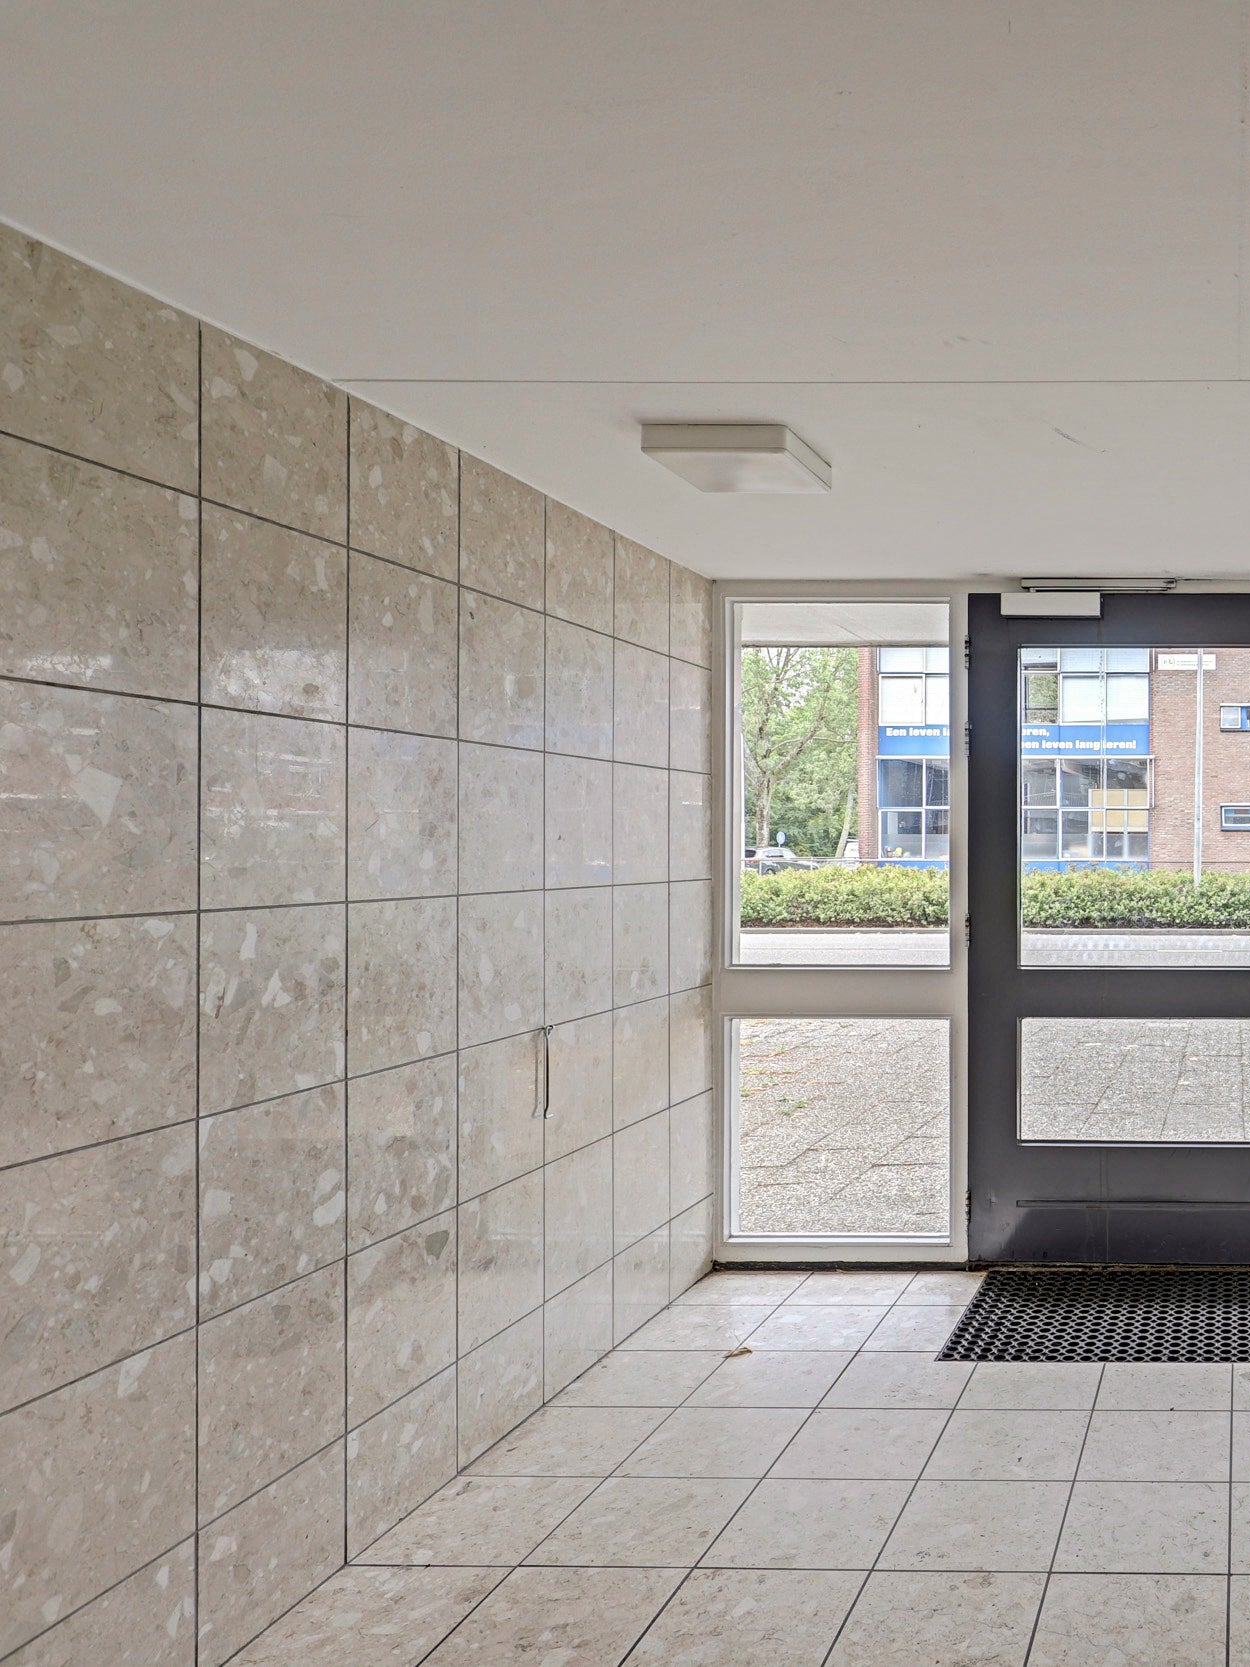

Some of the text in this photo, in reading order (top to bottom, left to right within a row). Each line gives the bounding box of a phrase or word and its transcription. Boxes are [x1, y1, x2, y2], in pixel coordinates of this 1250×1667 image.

[886, 727, 907, 737] Een
[909, 727, 940, 737] leven
[1041, 740, 1073, 749] leven
[1075, 740, 1100, 751] lang
